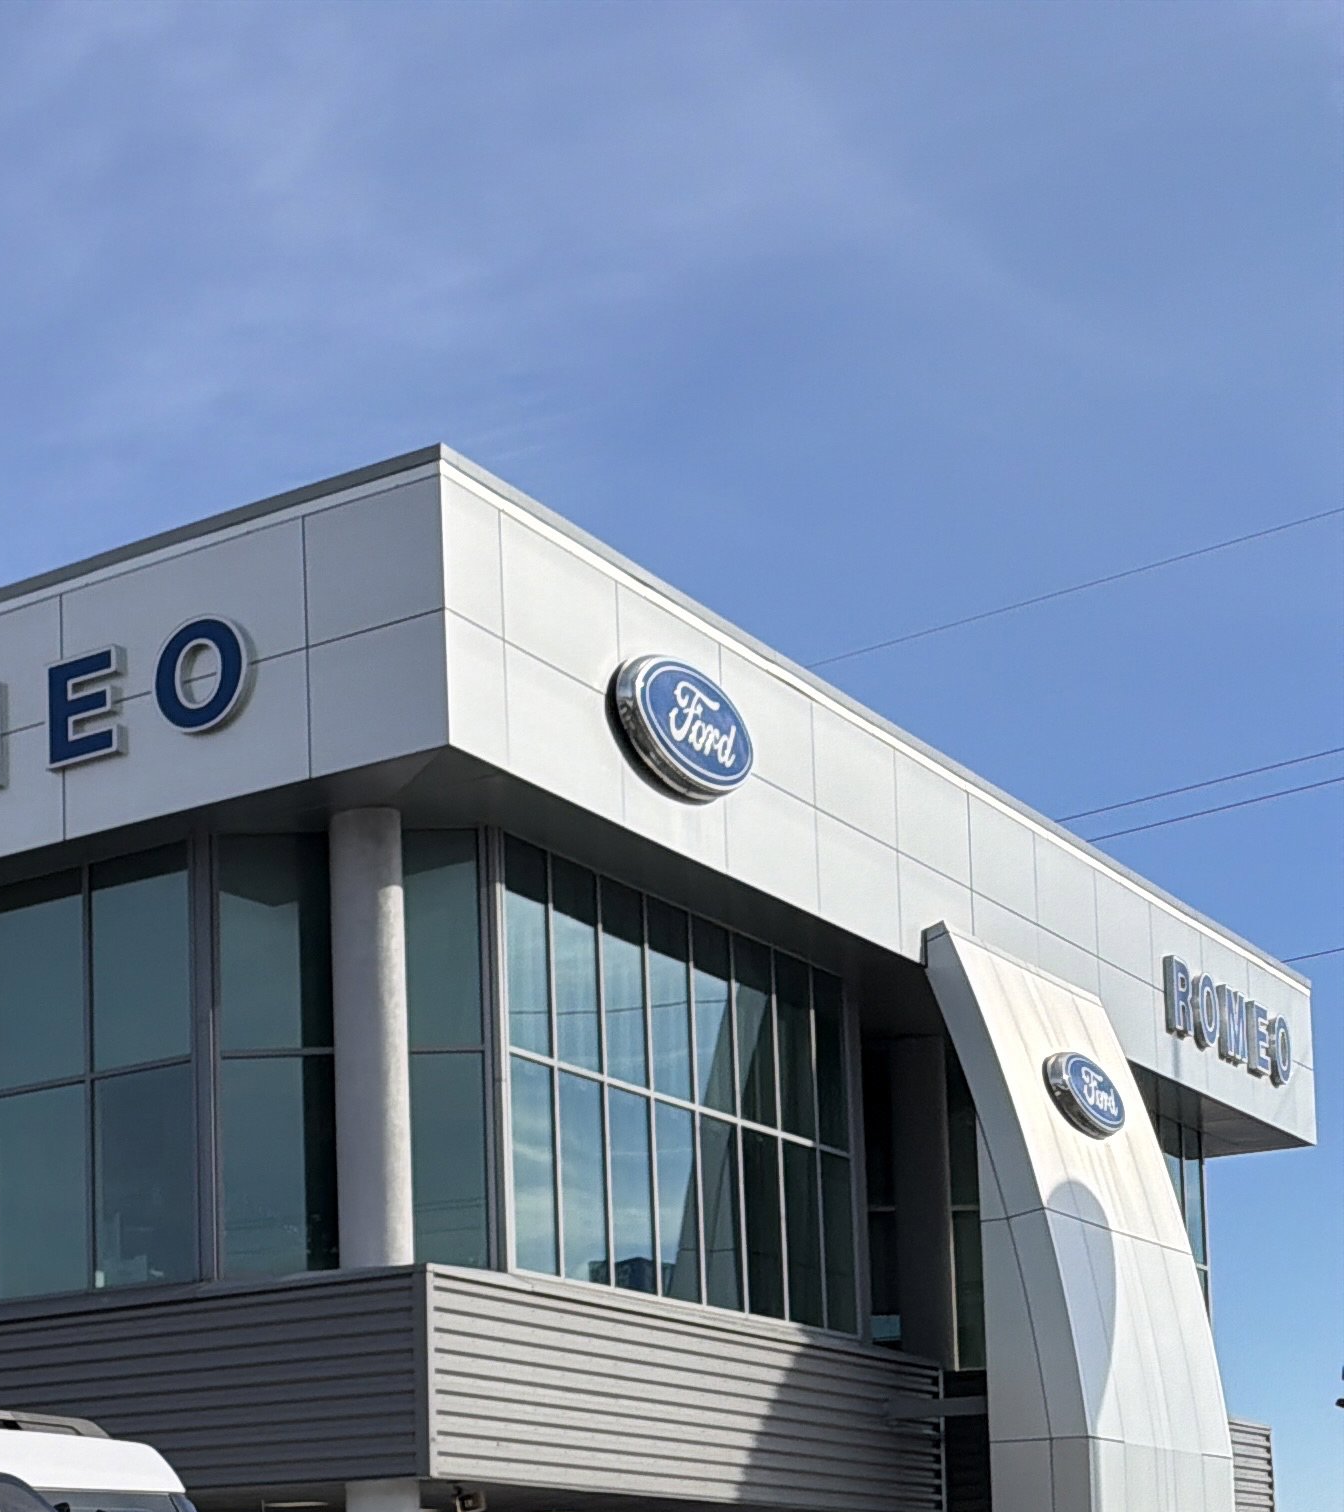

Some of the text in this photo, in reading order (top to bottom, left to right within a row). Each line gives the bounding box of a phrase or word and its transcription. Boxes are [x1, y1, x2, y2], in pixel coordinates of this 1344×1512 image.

[669, 680, 737, 769] Ford
[1162, 954, 1293, 1088] ROMEO
[1080, 1066, 1119, 1117] Ford
